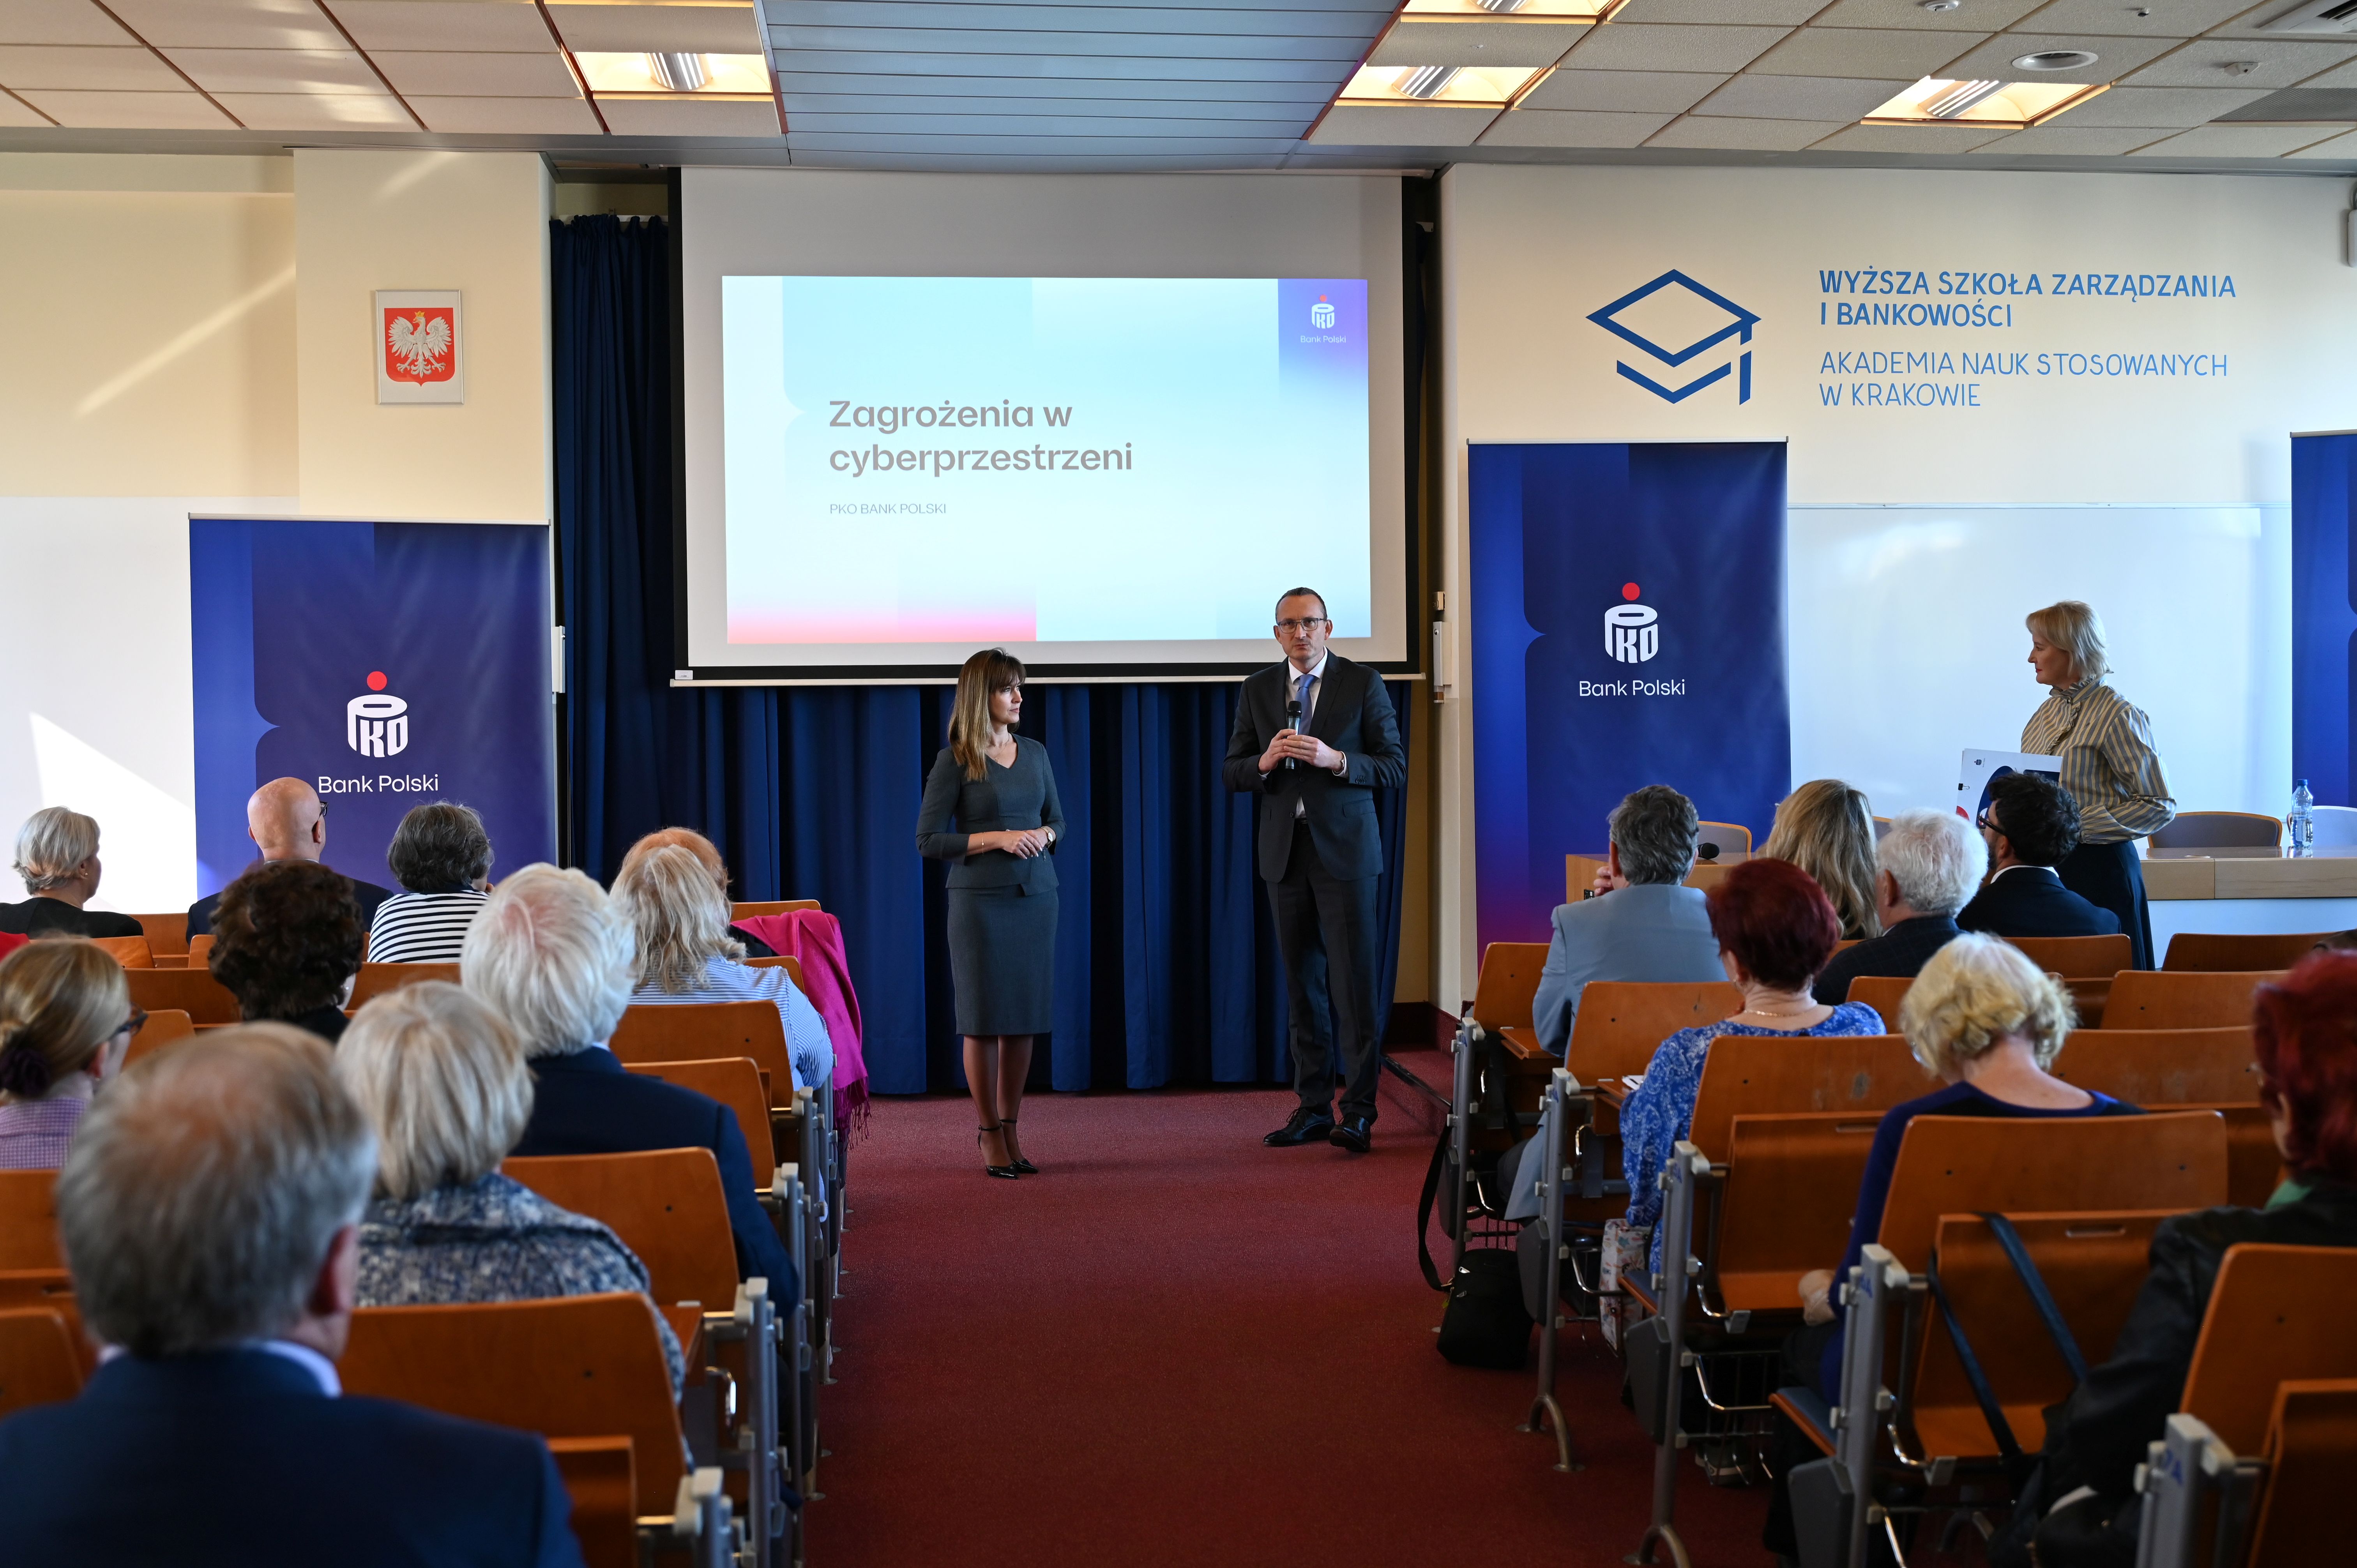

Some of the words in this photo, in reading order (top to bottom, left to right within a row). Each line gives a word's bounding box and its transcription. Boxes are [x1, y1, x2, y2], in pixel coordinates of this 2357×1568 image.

[1820, 266, 1930, 295] WYŻSZA
[1938, 271, 2043, 296] SZKOŁA
[2052, 274, 2237, 303] ZARZĄDZANIA
[1821, 302, 1827, 325] I
[1837, 299, 2012, 327] BANKOWOŚCI
[1323, 335, 1346, 343] Polski
[1820, 351, 1954, 375] AKADEMIA
[1963, 353, 2029, 375] NAUK
[2037, 353, 2228, 377] STOSOWANYCH
[1819, 383, 1843, 406] W
[1852, 383, 1982, 407] KRAKOWIE
[829, 399, 1034, 434] Zagrożenia
[1043, 406, 1072, 427] w
[829, 442, 1132, 478] cyberprzestrzeni
[830, 503, 857, 514] PKO
[860, 503, 897, 514] BANK
[900, 503, 946, 514] POLSKI
[1604, 604, 1658, 663] PKO
[1579, 680, 1627, 696] Bank
[1633, 679, 1685, 696] Polski
[347, 694, 408, 758] PKO
[318, 776, 373, 793] Bank
[379, 773, 438, 792] Polski
